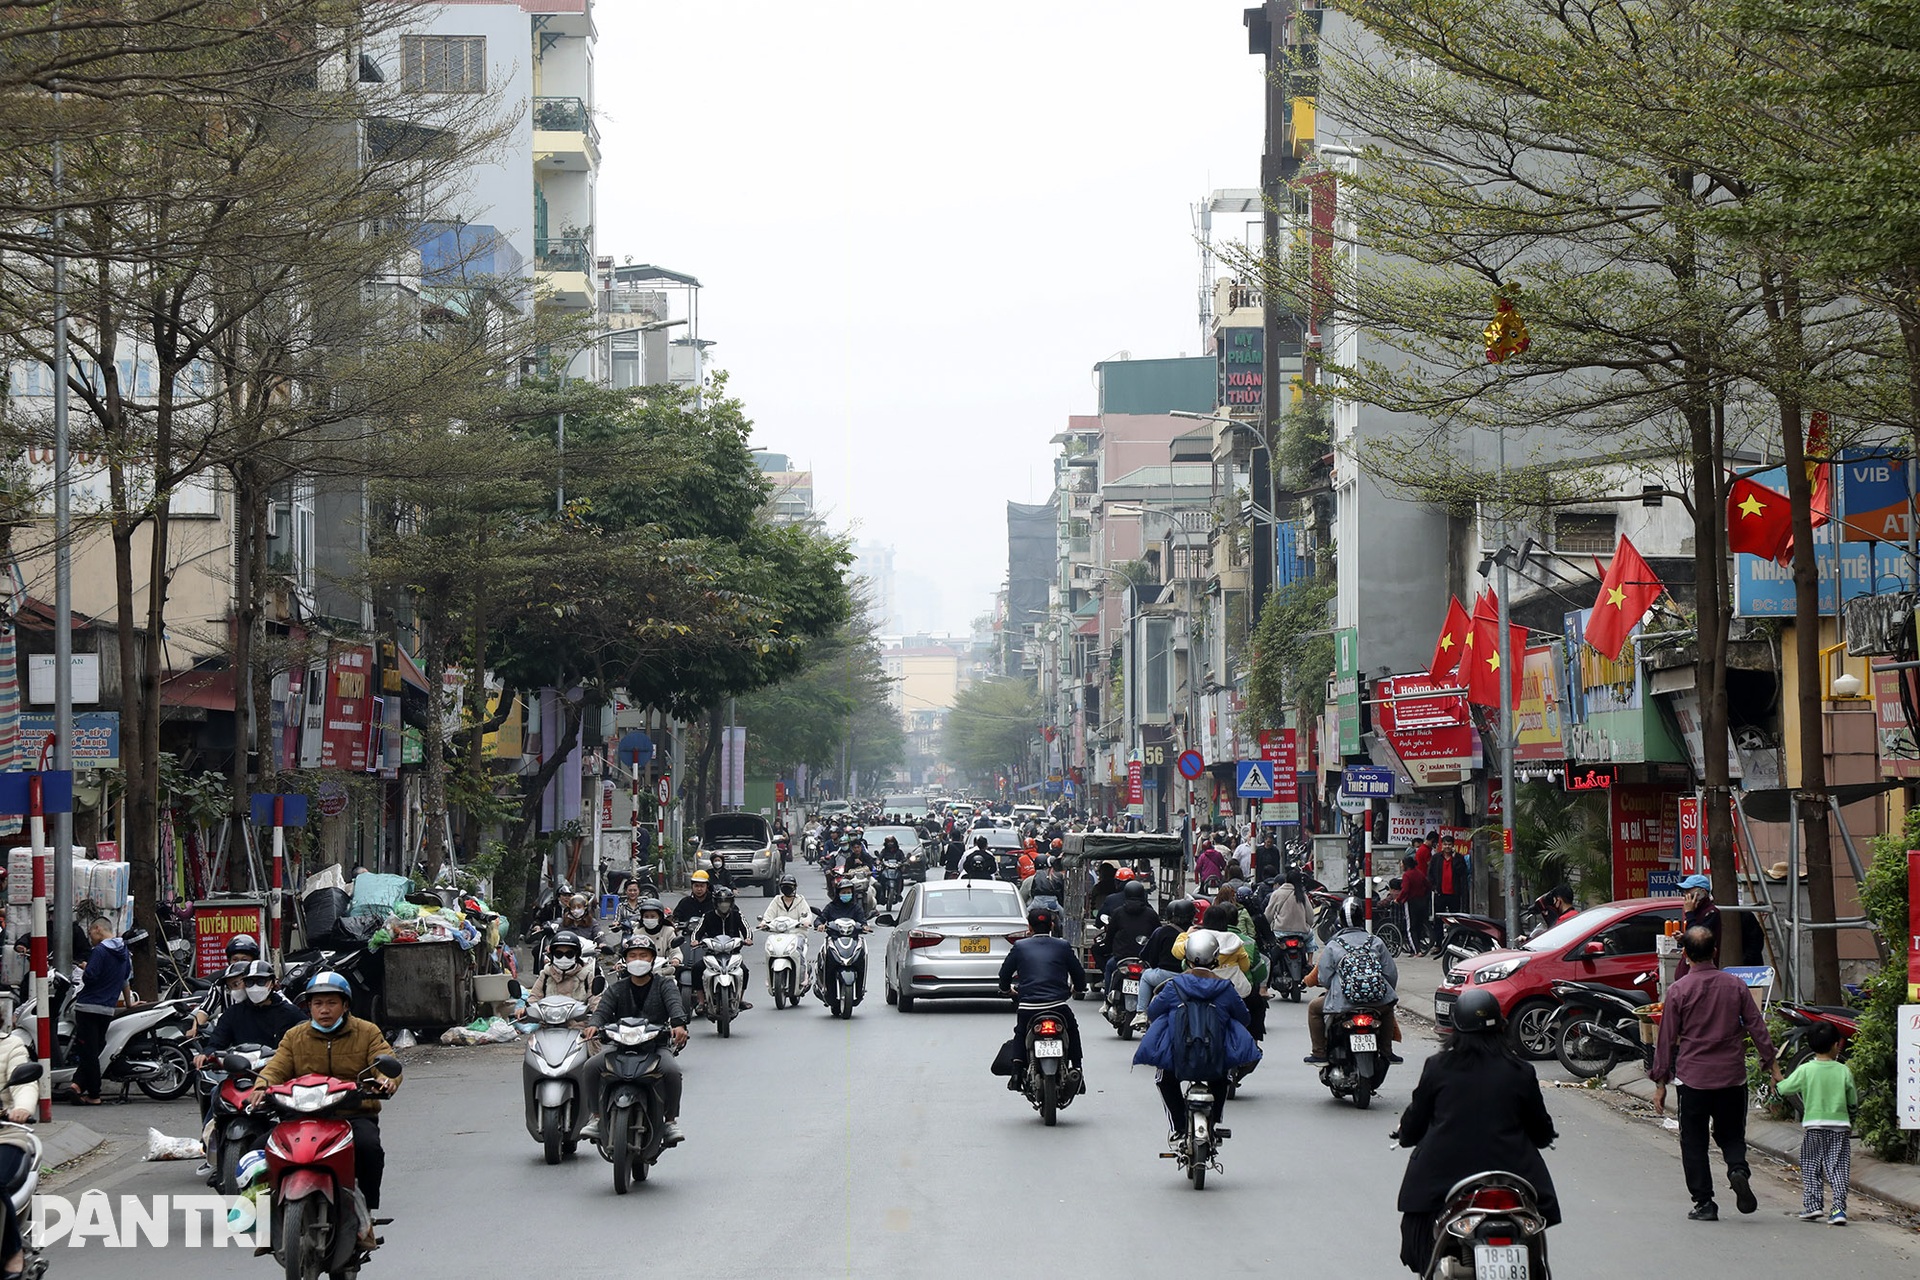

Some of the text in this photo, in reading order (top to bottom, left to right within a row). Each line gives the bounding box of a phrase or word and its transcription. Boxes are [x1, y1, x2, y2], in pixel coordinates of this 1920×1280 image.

[1229, 370, 1263, 386] XUÂN
[1228, 386, 1261, 403] THỦY
[1853, 466, 1890, 483] VIB
[1883, 513, 1920, 534] AT
[1145, 746, 1164, 765] 56
[1348, 780, 1389, 793] THIÊN HÙNG
[1682, 808, 1697, 829] SỬ
[198, 910, 228, 934] TUYỂN
[1484, 1248, 1519, 1263] 18-B1
[1480, 1265, 1527, 1280] 350.83
